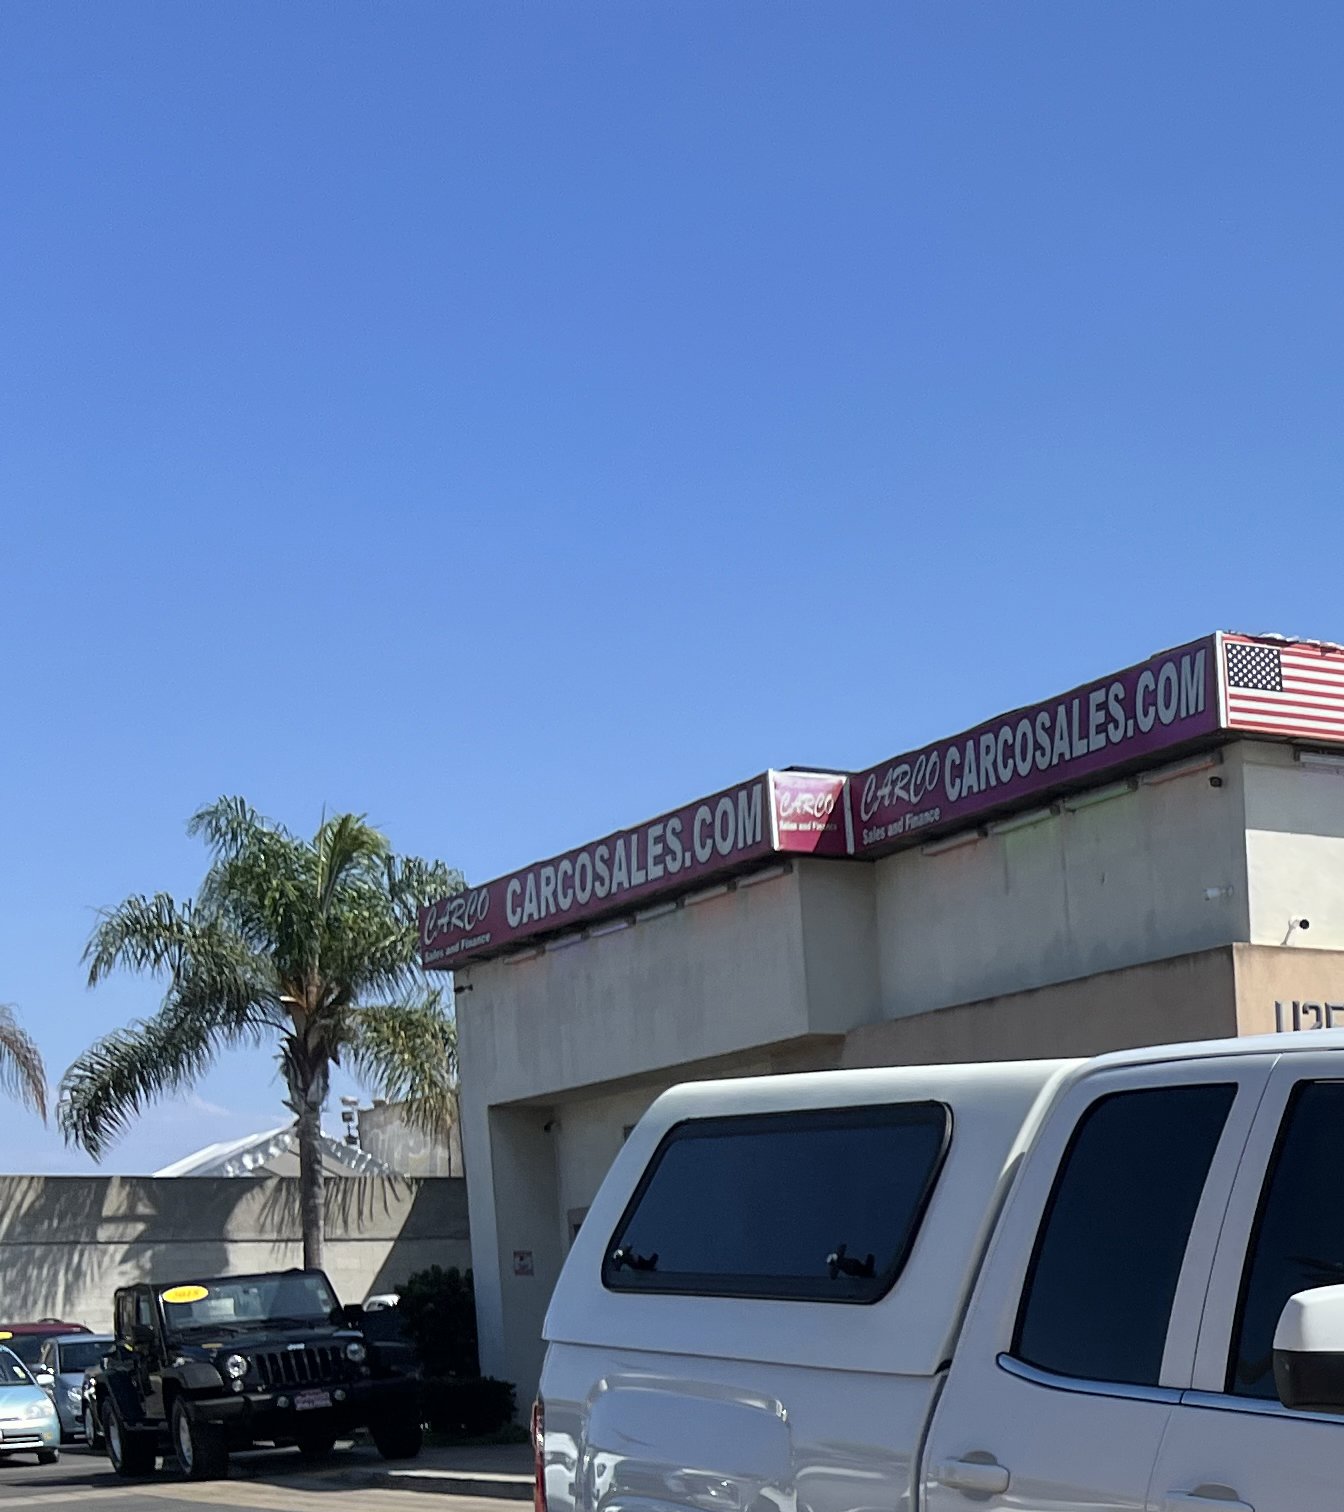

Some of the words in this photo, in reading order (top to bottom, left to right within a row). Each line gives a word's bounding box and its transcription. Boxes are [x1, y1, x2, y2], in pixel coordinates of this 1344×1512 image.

[780, 791, 835, 818] CARCO
[861, 750, 940, 823] CARCO
[944, 649, 1207, 802] CARCOSALES.COM
[424, 888, 490, 946] CARCO
[506, 783, 763, 928] CARCOSALES.COM
